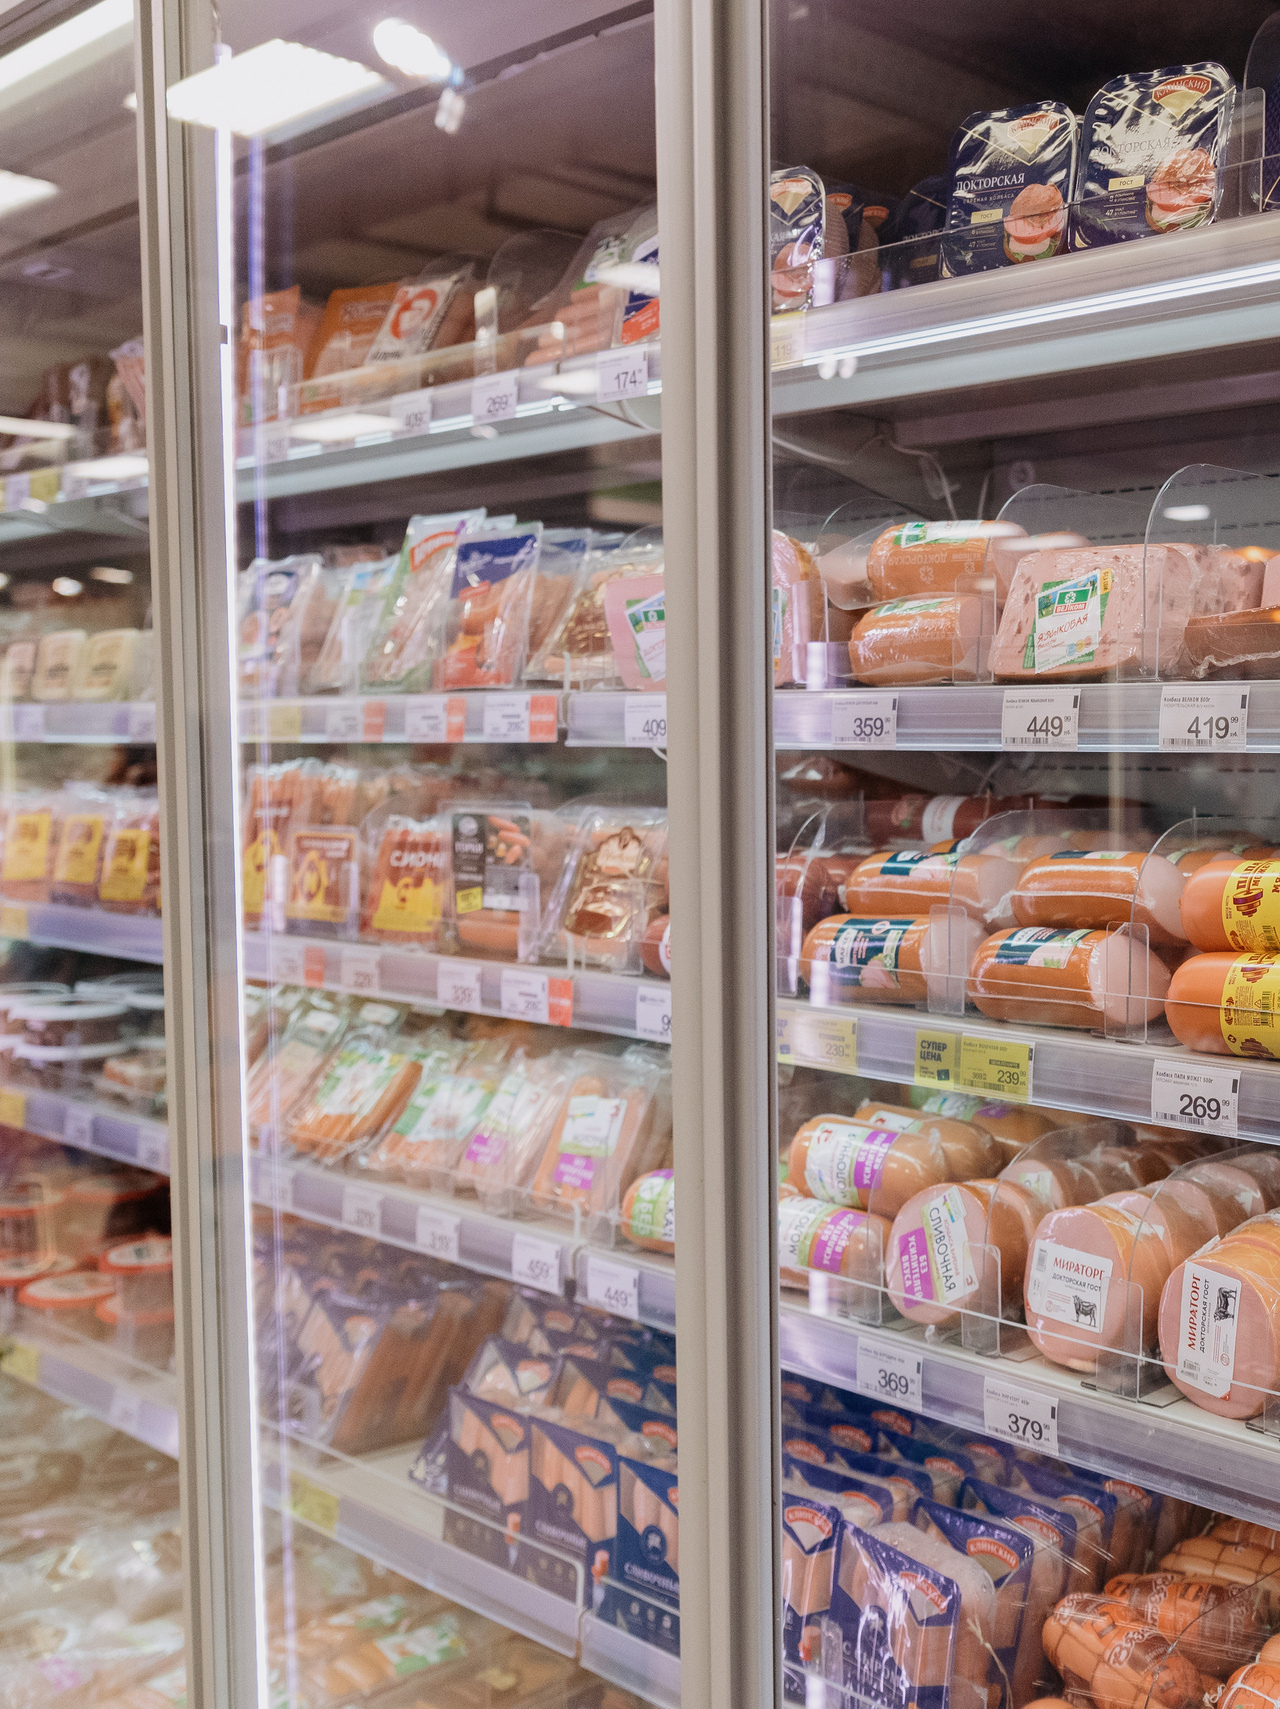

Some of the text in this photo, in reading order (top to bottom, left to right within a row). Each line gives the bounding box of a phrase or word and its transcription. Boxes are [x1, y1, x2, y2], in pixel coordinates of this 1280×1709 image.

[956, 172, 1025, 192] ДОКТОРСКАЯ
[615, 370, 637, 390] 174
[1056, 603, 1086, 613] ВЕЛКОМ
[1037, 613, 1089, 644] ЯЗЫКОВАЯ
[642, 719, 667, 736] 409
[853, 717, 884, 737] 359
[1027, 716, 1063, 737] 449
[1187, 716, 1229, 739] 419
[825, 1043, 845, 1058] 239
[920, 1039, 947, 1052] СУПЕР
[920, 1051, 942, 1062] ЦЕНА
[997, 1069, 1020, 1086] 239
[1187, 1074, 1202, 1082] МОЖЕТ
[1179, 1094, 1230, 1120] 269 99
[929, 1207, 957, 1292] СЛИВОЧНАЯ
[901, 1255, 912, 1288] ВКУСА
[908, 1235, 924, 1299] УСИЛИТЕЛЕЙ
[919, 1254, 929, 1274] БЕЗ
[1053, 1257, 1105, 1281] МИРАТОРГ
[1052, 1273, 1102, 1293] ДОКТОРСКАЯ ГОСТ
[1187, 1273, 1201, 1351] МИРАТОРГ
[1200, 1302, 1208, 1353] ДОКТОРСКАЯ
[878, 1369, 908, 1395] 369
[1008, 1413, 1043, 1441] 379
[970, 1541, 1017, 1566] КЛИНСКИЙ
